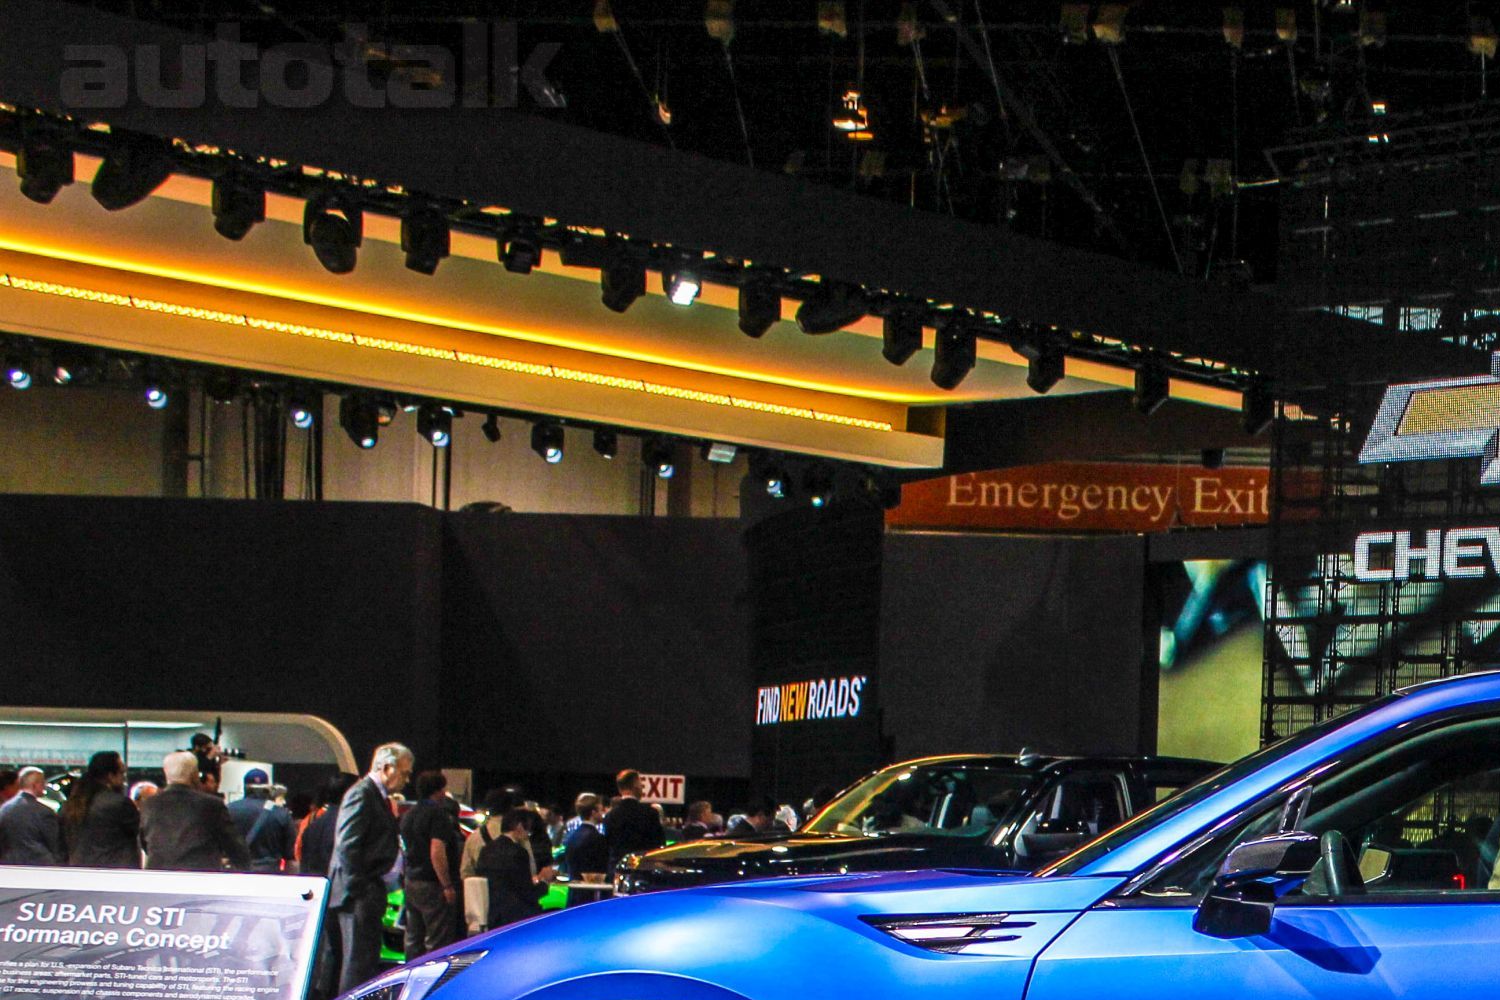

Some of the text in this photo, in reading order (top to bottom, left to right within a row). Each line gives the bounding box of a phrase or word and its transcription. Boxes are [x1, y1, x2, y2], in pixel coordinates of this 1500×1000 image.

[946, 473, 1269, 521] Emergency Exit
[17, 902, 186, 927] SUBARU STI
[126, 927, 230, 953] Concept
